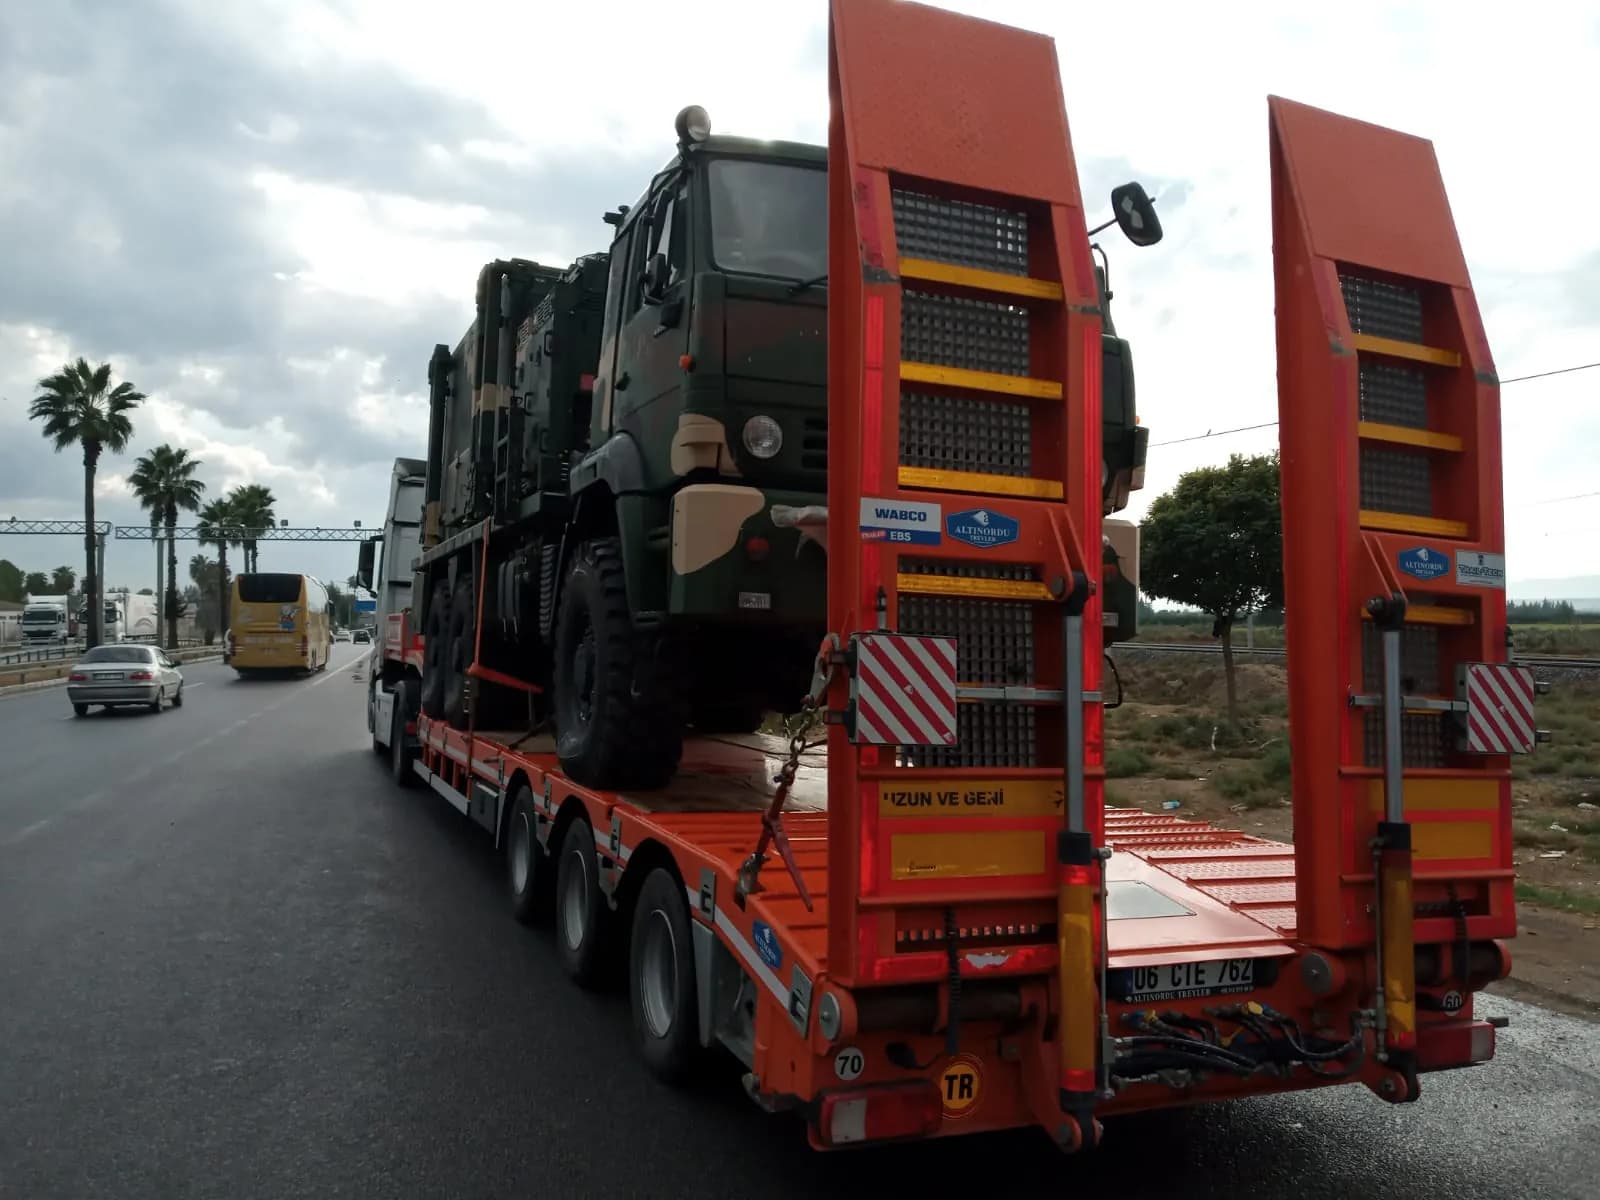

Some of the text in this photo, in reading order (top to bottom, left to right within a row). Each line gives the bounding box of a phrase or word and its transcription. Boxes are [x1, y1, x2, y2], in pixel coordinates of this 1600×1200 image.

[875, 507, 927, 522] WABCO
[890, 531, 912, 542] EBS
[955, 525, 1010, 537] ALTINORDU
[937, 791, 960, 806] VE
[1135, 967, 1158, 989] 06
[838, 1055, 862, 1075] 70
[944, 1073, 974, 1100] TR
